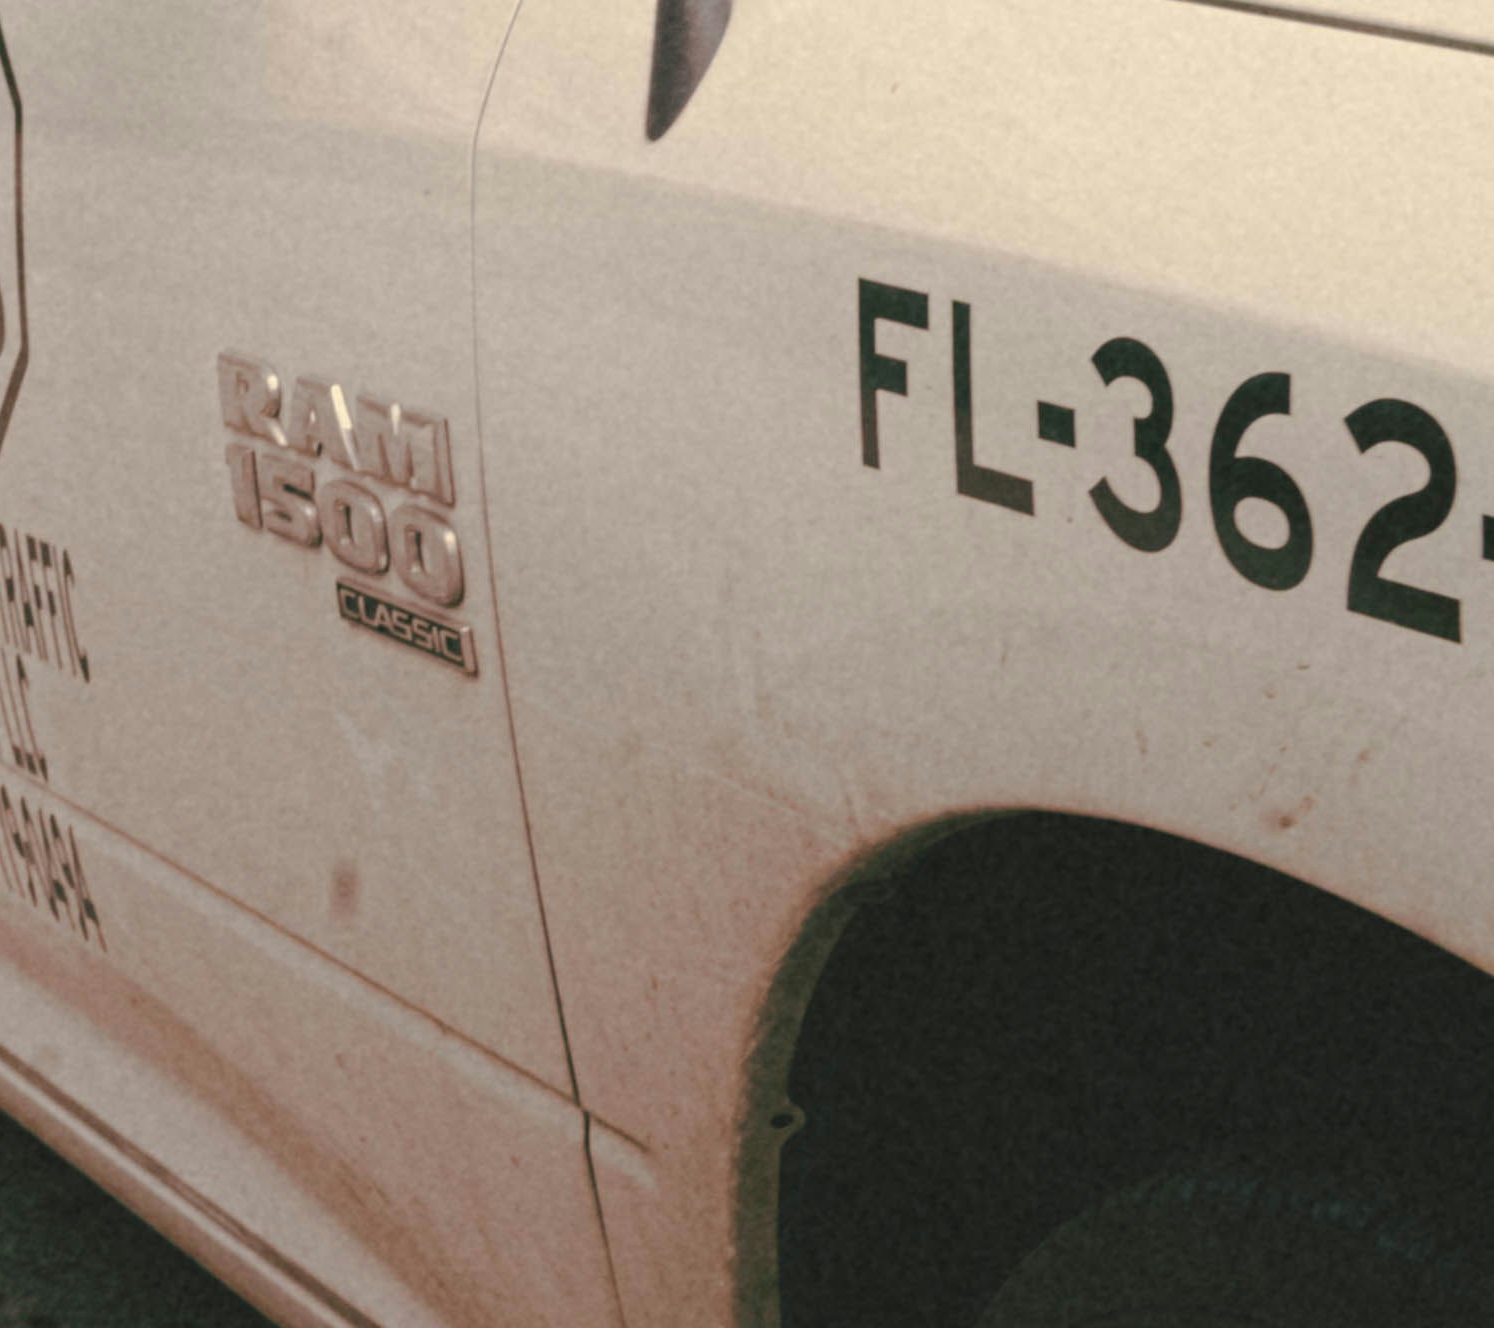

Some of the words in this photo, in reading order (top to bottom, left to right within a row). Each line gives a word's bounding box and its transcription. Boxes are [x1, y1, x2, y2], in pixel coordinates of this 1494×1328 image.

[216, 350, 457, 511] RAM
[856, 275, 1494, 646] FL-362
[224, 443, 466, 609] 1500
[338, 586, 466, 665] CLASSIC
